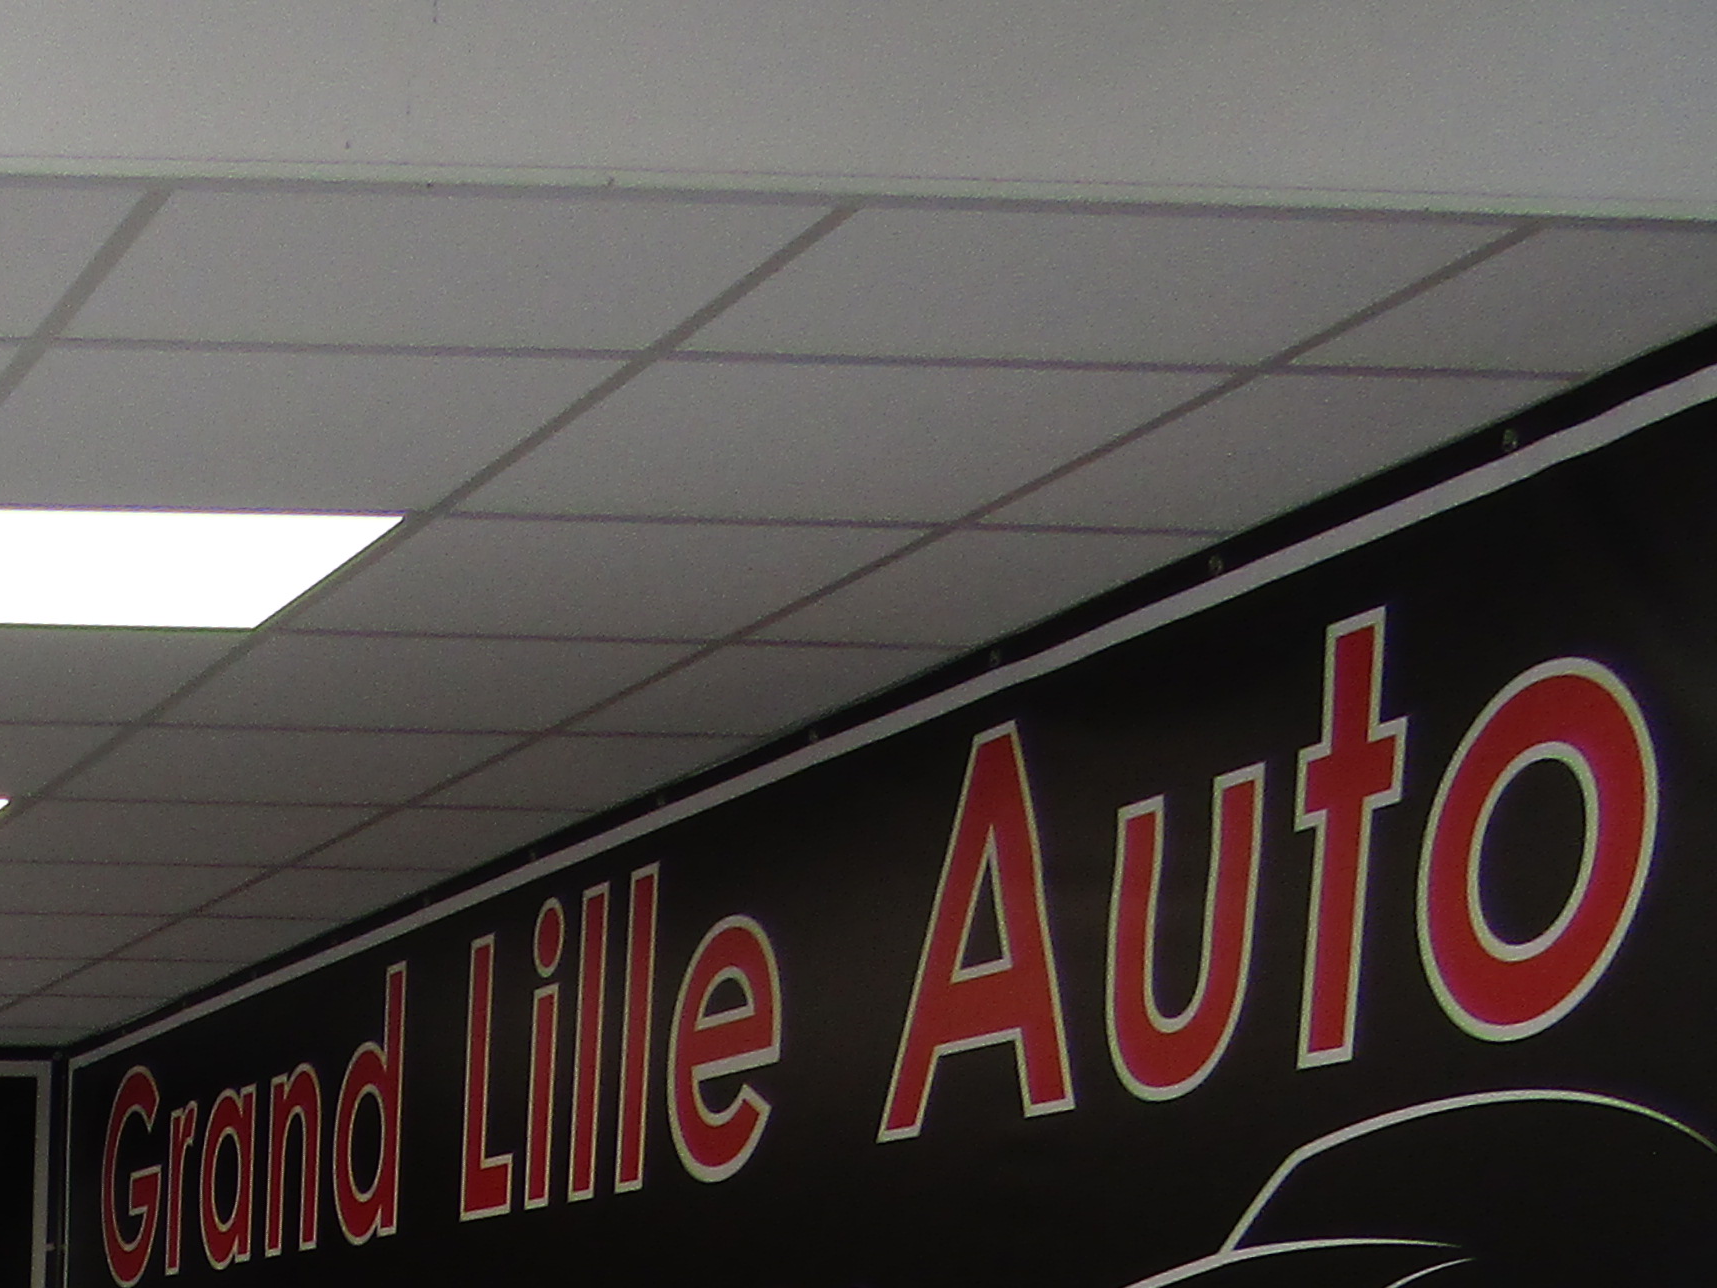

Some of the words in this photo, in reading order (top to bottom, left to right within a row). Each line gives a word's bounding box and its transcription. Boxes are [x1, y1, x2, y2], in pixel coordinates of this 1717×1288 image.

[101, 961, 407, 1288] Grand
[459, 861, 783, 1222] Lille
[876, 605, 1660, 1143] Auto
